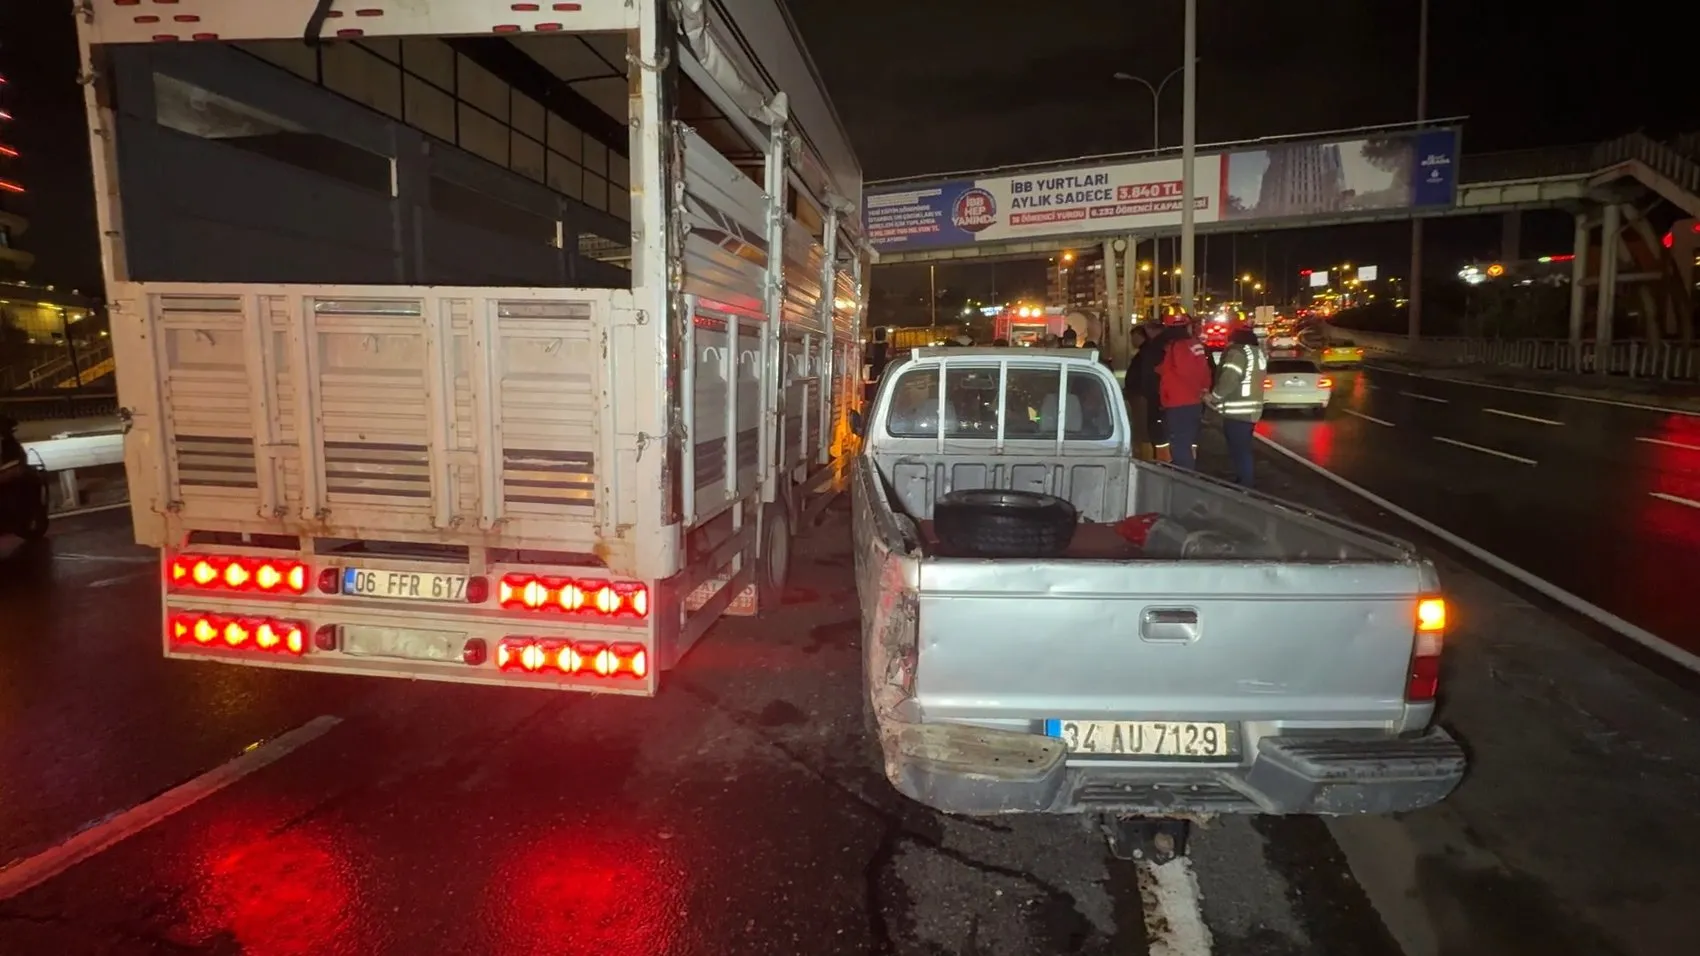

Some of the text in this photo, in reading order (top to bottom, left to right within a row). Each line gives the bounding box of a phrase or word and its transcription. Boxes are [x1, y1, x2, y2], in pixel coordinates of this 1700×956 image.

[1011, 173, 1108, 194] İBB YURTLARI
[1119, 182, 1182, 200] 3.840 TL
[1012, 188, 1113, 209] AYLIK SADECE
[964, 206, 986, 217] HEP
[355, 571, 466, 599] 06 FFR 617
[1064, 723, 1218, 755] 34 AU 7129
